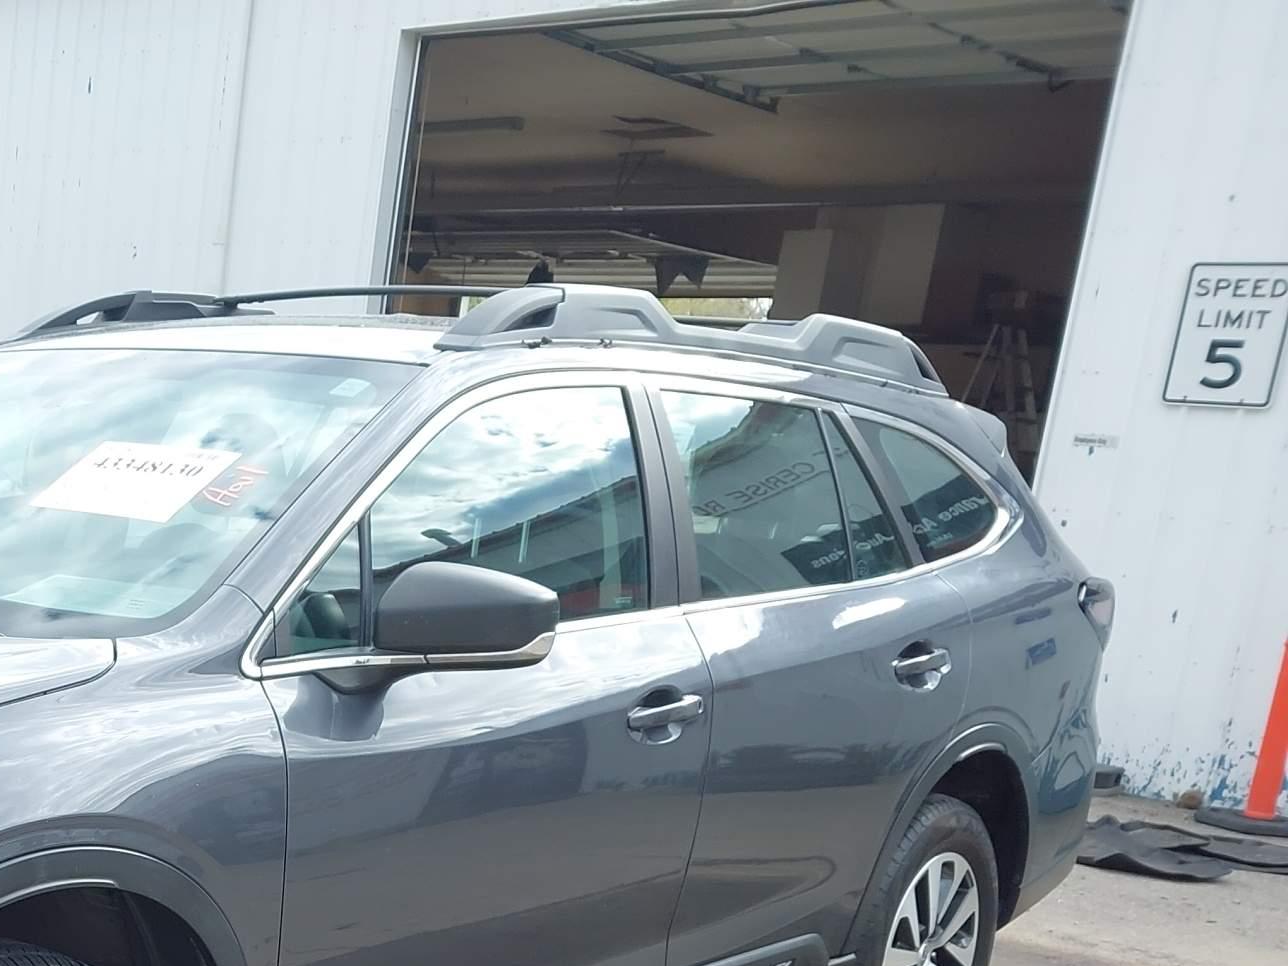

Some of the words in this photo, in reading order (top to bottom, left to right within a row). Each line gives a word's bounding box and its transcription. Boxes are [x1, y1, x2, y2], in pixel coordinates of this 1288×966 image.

[1194, 277, 1288, 299] SPEED
[1196, 309, 1272, 330] LIMIT
[1199, 338, 1246, 390] 5
[92, 456, 205, 478] 43348130
